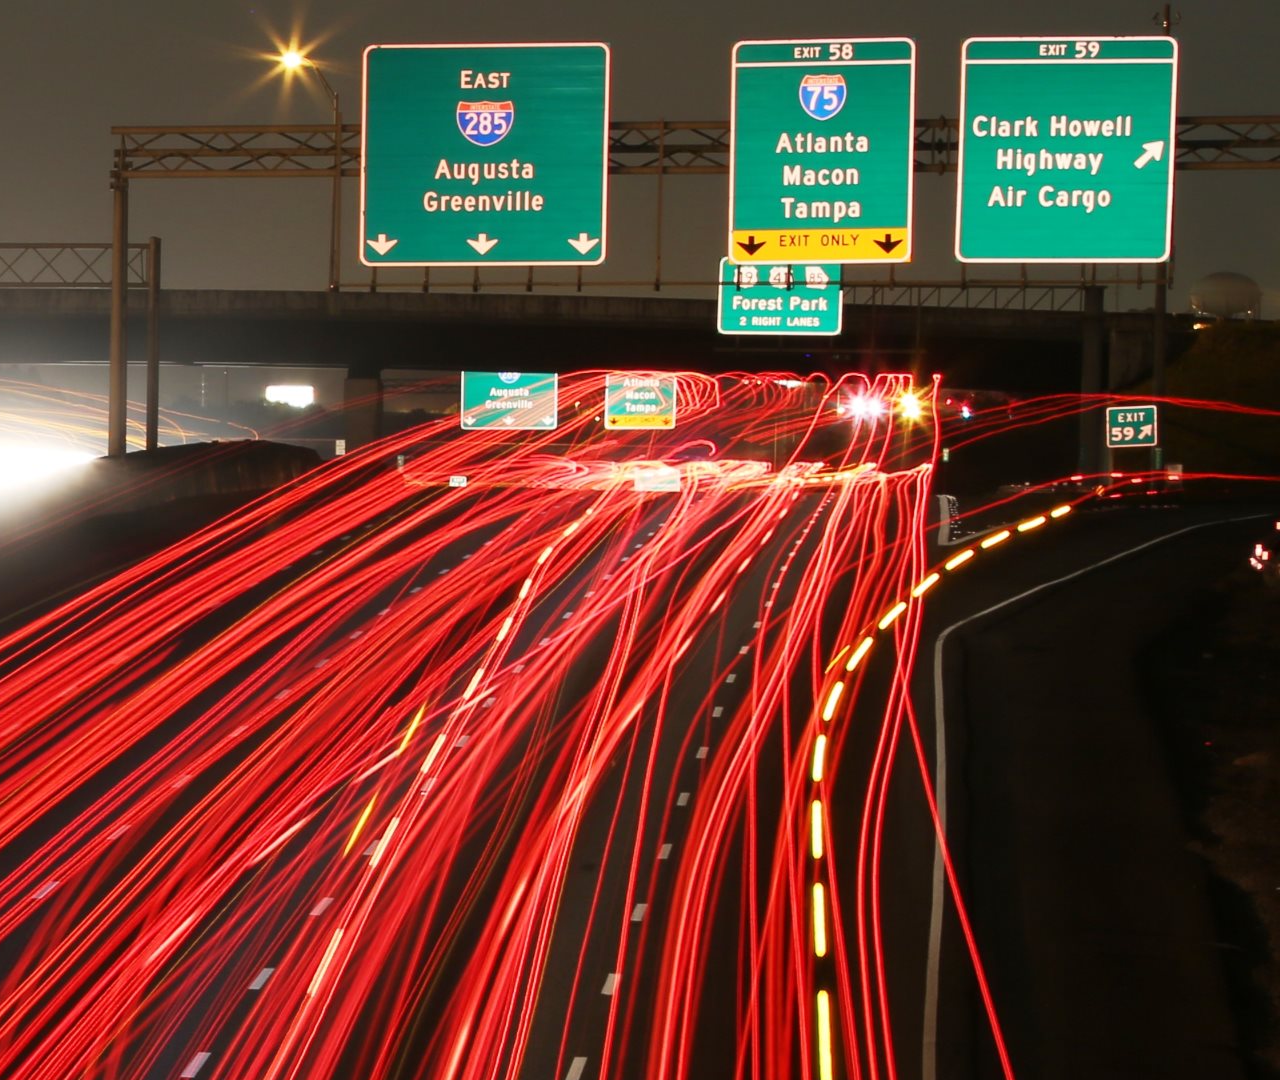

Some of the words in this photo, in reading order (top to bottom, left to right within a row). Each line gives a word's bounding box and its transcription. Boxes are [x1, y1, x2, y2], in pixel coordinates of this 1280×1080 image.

[794, 47, 821, 59] EXIT
[829, 44, 853, 60] 58
[1039, 44, 1067, 56] EXIT
[1075, 42, 1100, 58] 59
[460, 71, 510, 89] EAST
[807, 87, 838, 110] 75
[465, 113, 507, 135] 285
[973, 115, 1039, 137] Clark
[1050, 115, 1132, 137] Howell
[776, 132, 868, 154] Atlanta
[996, 149, 1103, 176] Highway
[435, 159, 534, 185] Augusta
[783, 166, 859, 186] Macon
[423, 190, 544, 212] Greenville
[987, 186, 1026, 207] Air
[1038, 186, 1111, 213] Cargo
[781, 197, 861, 223] Tampa
[780, 235, 810, 247] EXIT
[821, 234, 860, 246] ONLY
[732, 296, 783, 310] Forest
[790, 296, 828, 311] Park
[740, 317, 747, 326] 2
[752, 317, 782, 326] RIGHT
[787, 317, 820, 327] LANES
[490, 387, 529, 398] Augusta
[626, 391, 656, 399] Macon
[485, 400, 533, 409] Greenville
[625, 402, 656, 412] Tampa
[1118, 412, 1145, 422] EXIT
[1112, 427, 1134, 441] 59
